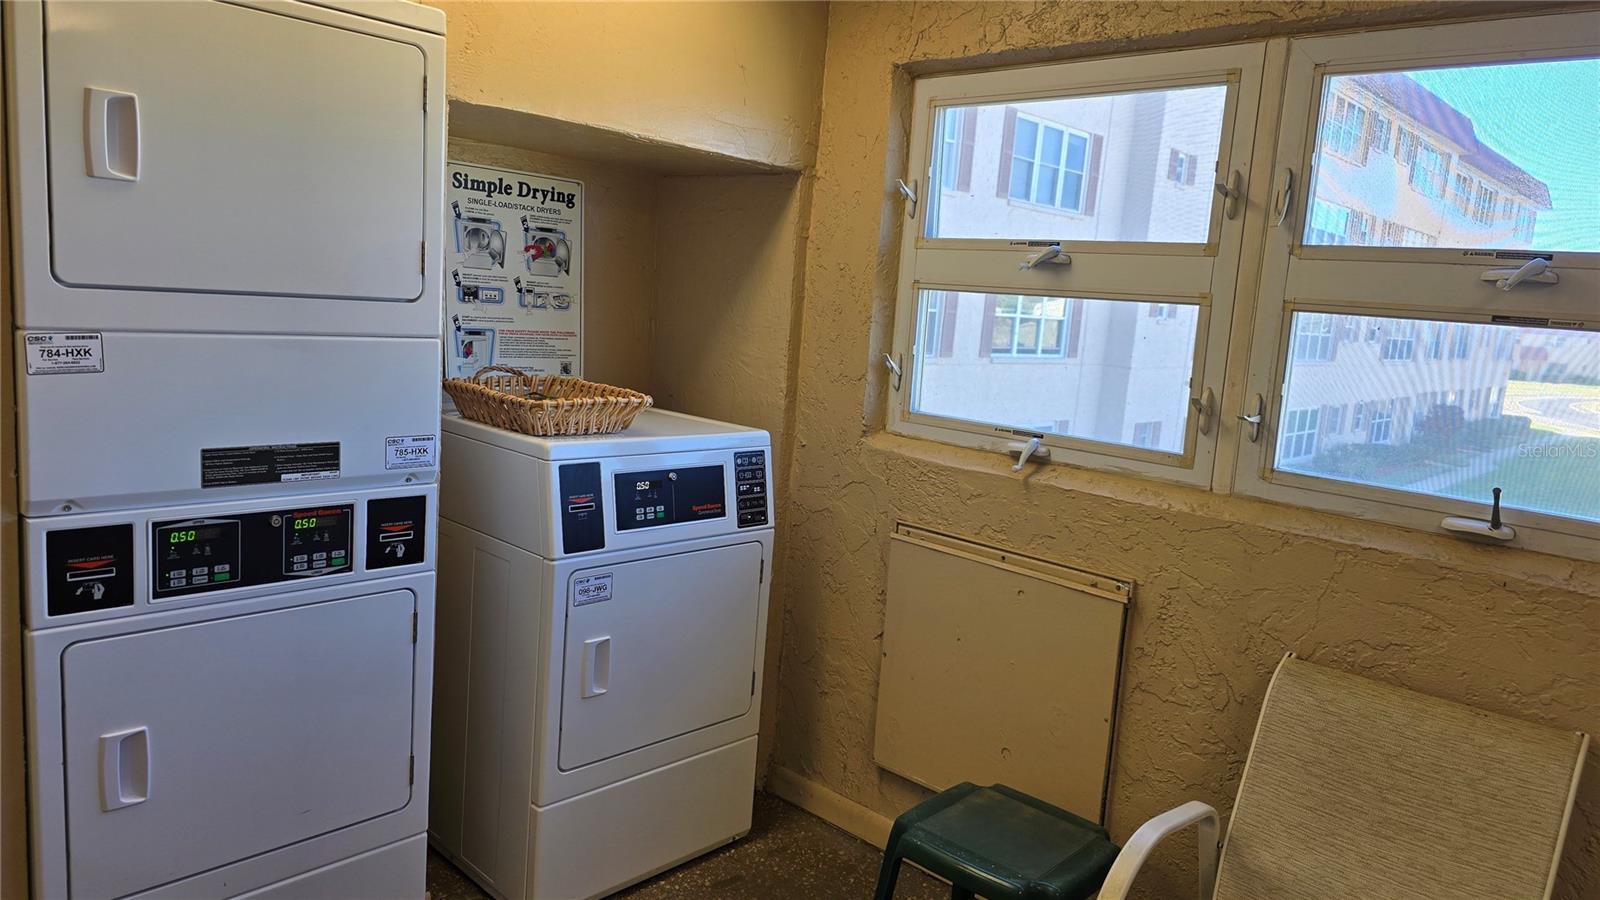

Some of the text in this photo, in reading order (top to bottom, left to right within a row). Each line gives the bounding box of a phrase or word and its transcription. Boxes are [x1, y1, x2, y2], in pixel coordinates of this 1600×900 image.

[452, 172, 576, 209] Simple Drying
[467, 197, 535, 212] SINGLE-LOAD/STACK
[536, 206, 562, 216] DRYERS
[39, 348, 93, 358] 784-HXK
[394, 447, 429, 456] 785-HXK
[295, 518, 317, 529] 0.50
[170, 530, 196, 543] 0.50
